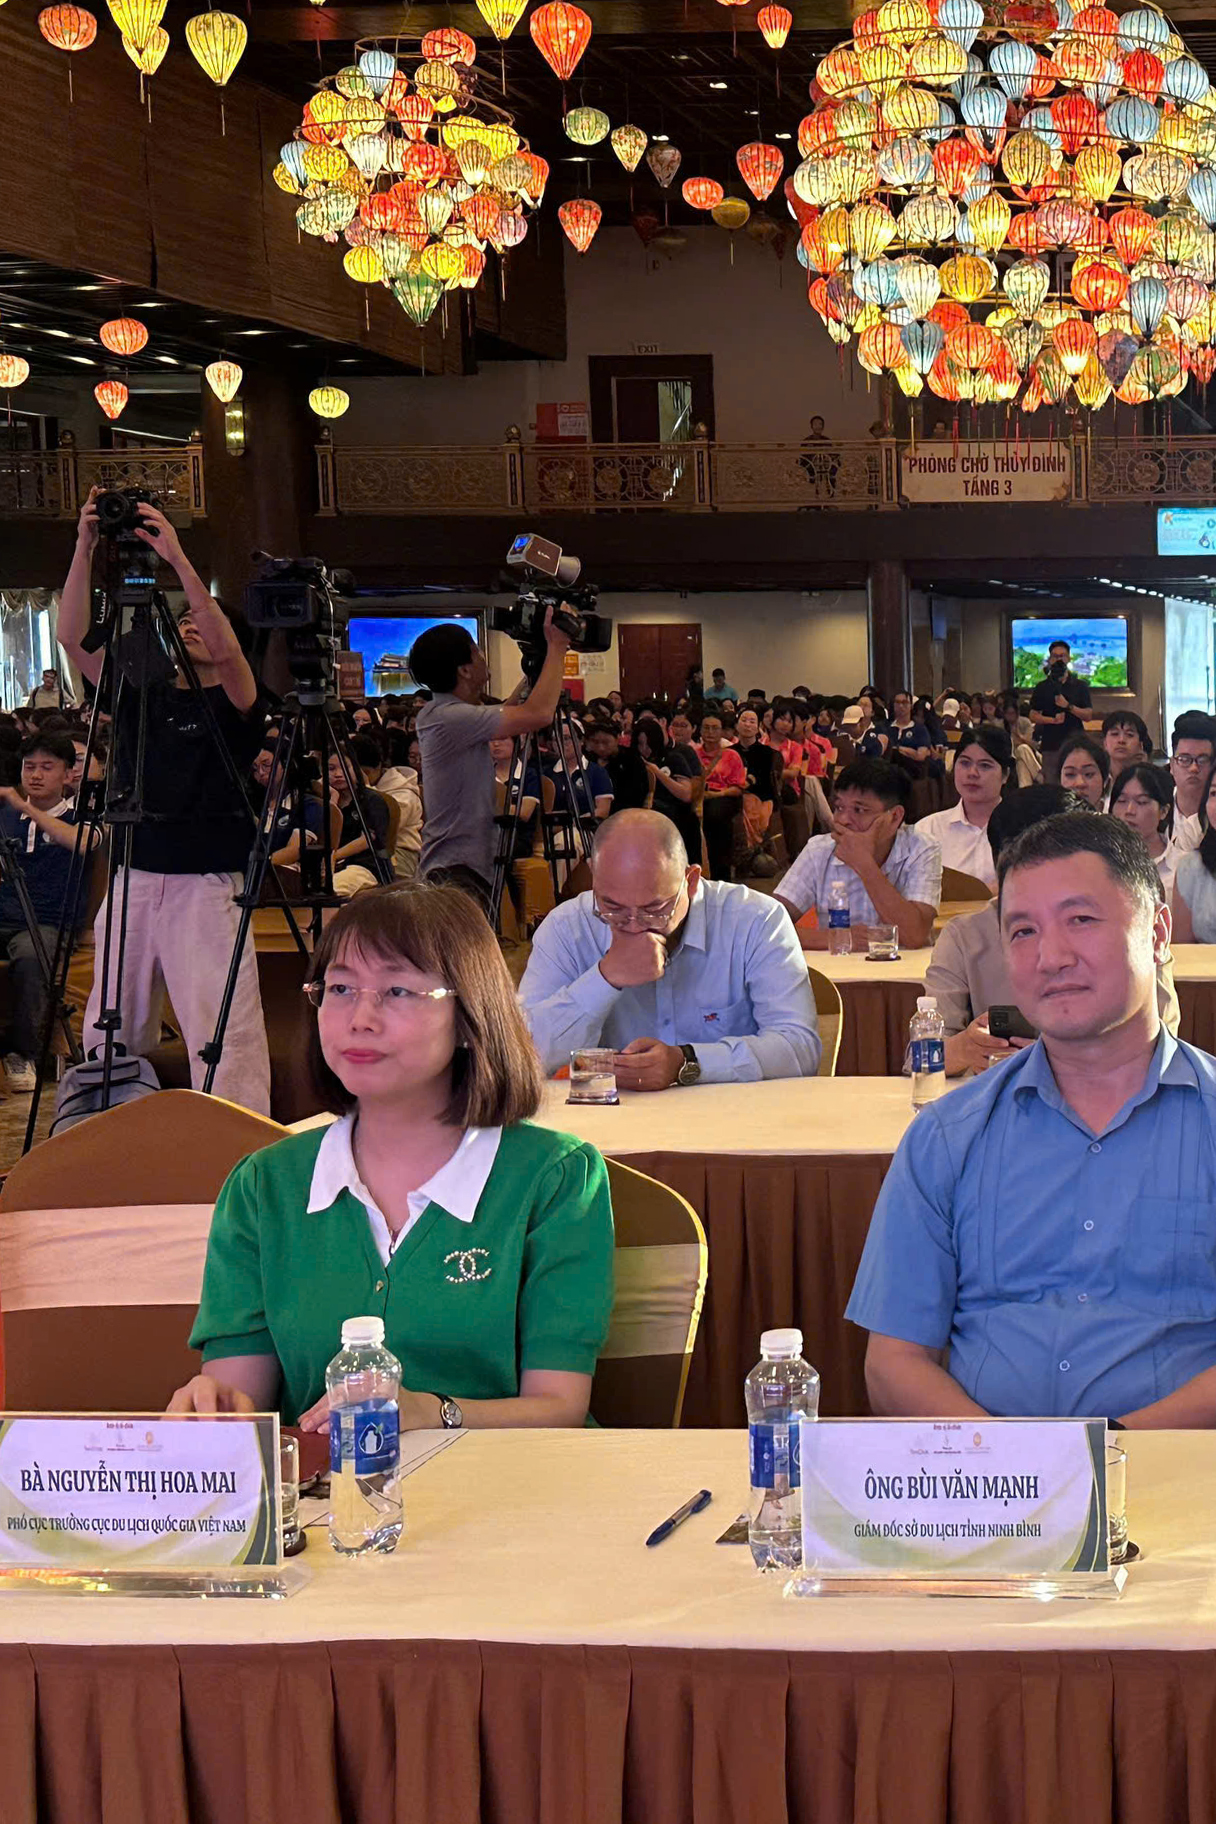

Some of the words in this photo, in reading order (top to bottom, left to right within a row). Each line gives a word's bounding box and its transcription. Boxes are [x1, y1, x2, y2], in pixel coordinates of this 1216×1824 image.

[908, 453, 956, 473] PHÒNG
[961, 453, 989, 473] CHỜ
[1032, 453, 1066, 473] ĐÌNH
[963, 474, 999, 496] TẦNG
[1004, 480, 1012, 496] 3
[20, 1461, 44, 1492] BÀ
[49, 1460, 121, 1493] NGUYỄN
[125, 1470, 157, 1500] THỊ
[161, 1470, 198, 1494] HOA
[201, 1471, 236, 1494] MAI
[864, 1468, 903, 1499] ÔNG
[907, 1467, 938, 1499] BÙI
[942, 1468, 978, 1499] VĂN
[982, 1475, 1039, 1507] MẠNH
[7, 1512, 27, 1530] PHÓ
[28, 1517, 47, 1533] CỤC
[91, 1518, 110, 1534] CỤC
[112, 1518, 125, 1531] DU
[127, 1518, 150, 1535] LỊCH
[151, 1514, 178, 1534] QUỐC
[179, 1519, 196, 1532] GIA
[198, 1515, 220, 1536] VIỆT
[222, 1519, 246, 1533] NAM
[854, 1519, 881, 1537] GIÁM
[883, 1519, 904, 1537] ĐỐC
[905, 1518, 918, 1537] SỞ
[920, 1523, 934, 1537] DU
[936, 1523, 958, 1541] LỊCH
[960, 1518, 986, 1537] TỈNH
[988, 1523, 1014, 1537] NINH
[1016, 1519, 1041, 1537] BÌNH
